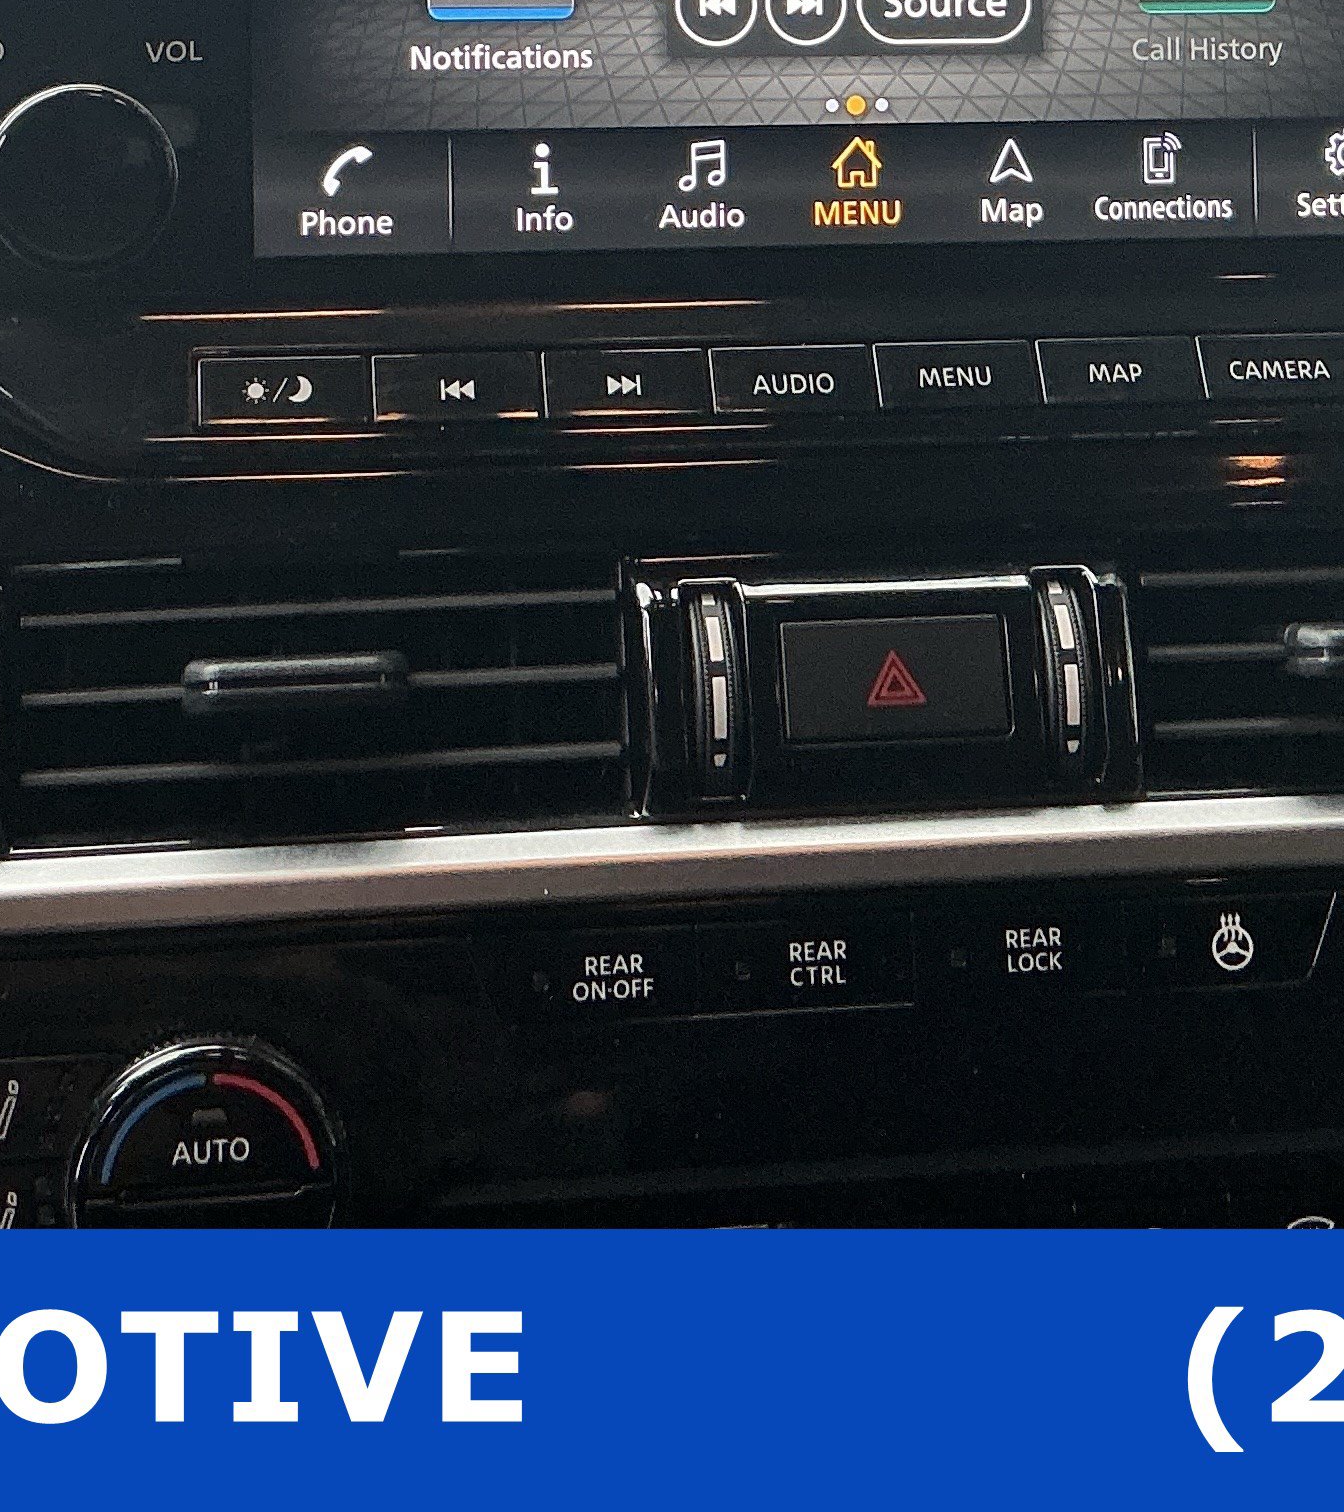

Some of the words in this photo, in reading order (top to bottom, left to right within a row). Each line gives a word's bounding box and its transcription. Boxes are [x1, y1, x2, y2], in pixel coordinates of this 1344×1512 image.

[145, 40, 204, 63] VOL
[409, 43, 593, 71] Notifications
[1132, 36, 1180, 62] Call
[1190, 36, 1283, 67] History
[516, 204, 574, 232] Info
[658, 201, 745, 229] Audio
[814, 199, 901, 226] MENU
[981, 197, 1045, 229] Map
[1094, 194, 1234, 221] Connections
[301, 209, 394, 237] Phone
[919, 365, 992, 388] MENU
[1089, 362, 1143, 383] MAP
[1229, 359, 1331, 380] CAMERA
[752, 372, 835, 396] AUDIO
[1005, 926, 1062, 949] REAR
[789, 939, 847, 963] REAR
[1007, 951, 1063, 973] LOCK
[584, 953, 644, 977] REAR
[790, 964, 847, 987] CTRL
[171, 1136, 250, 1166] AUTO
